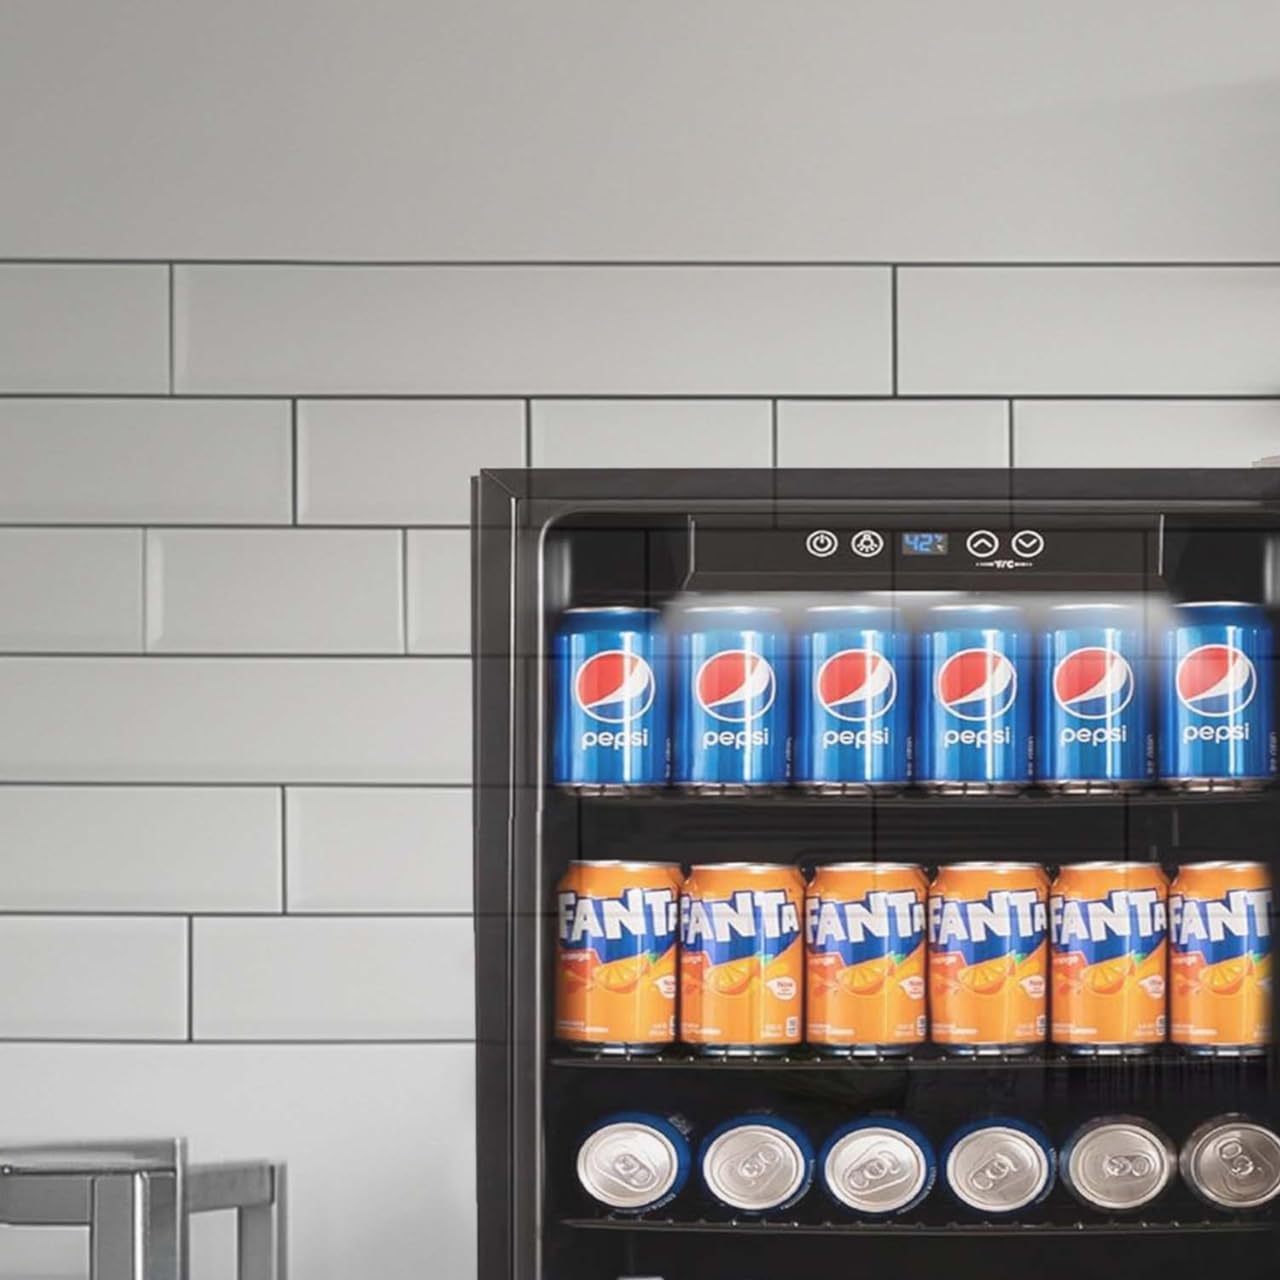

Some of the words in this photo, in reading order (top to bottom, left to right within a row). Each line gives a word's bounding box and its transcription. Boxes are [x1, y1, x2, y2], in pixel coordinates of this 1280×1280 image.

[581, 728, 648, 750] pepsi
[703, 728, 769, 749] pepsi
[822, 727, 889, 749] pepsi
[943, 726, 1011, 748] pepsi
[1060, 724, 1127, 746] pepsi
[1182, 722, 1250, 744] pepsi
[681, 891, 799, 945] FANTA
[929, 891, 1047, 945] FANTA
[1170, 890, 1272, 942] FANT
